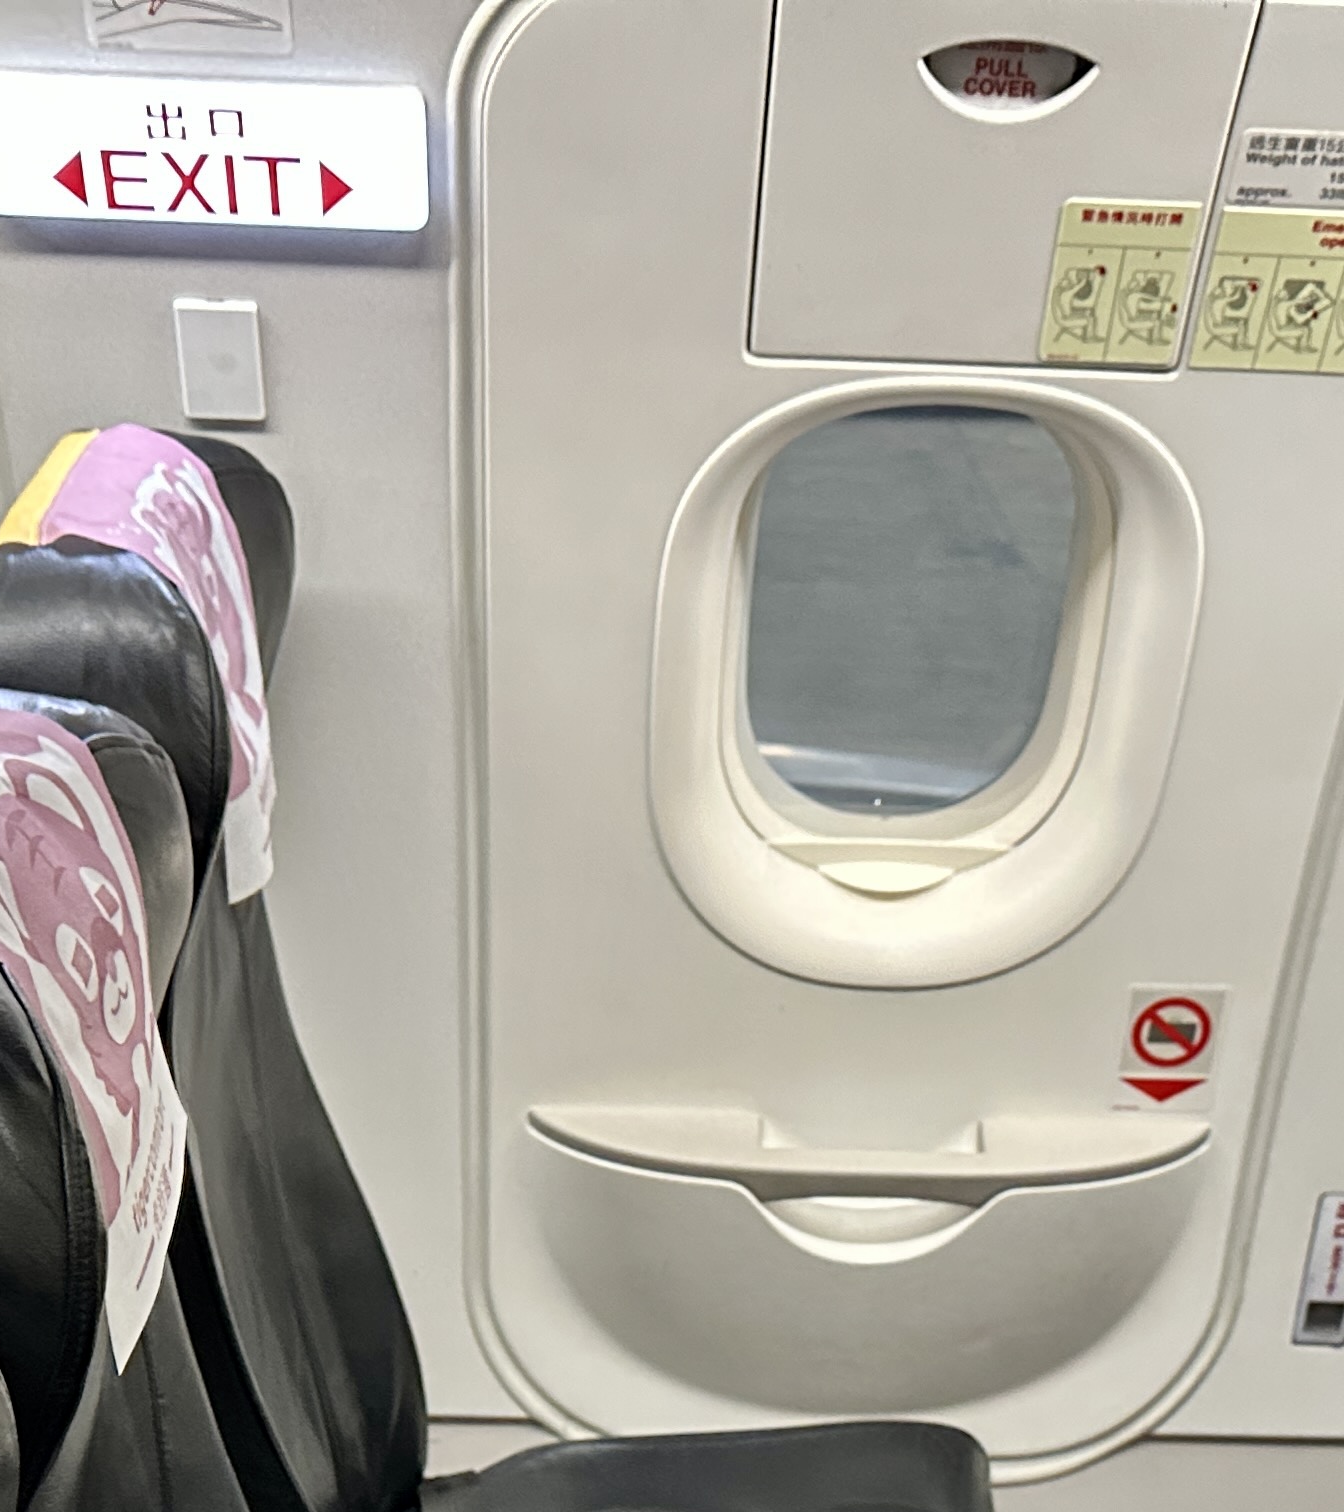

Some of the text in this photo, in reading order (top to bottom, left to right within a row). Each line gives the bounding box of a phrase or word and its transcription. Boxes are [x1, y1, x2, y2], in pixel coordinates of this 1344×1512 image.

[974, 56, 1029, 78] PULL
[963, 78, 1037, 98] COVER
[146, 102, 245, 141] 出口
[1246, 152, 1297, 167] Weight
[1301, 155, 1317, 166] of
[100, 150, 300, 216] EXIT
